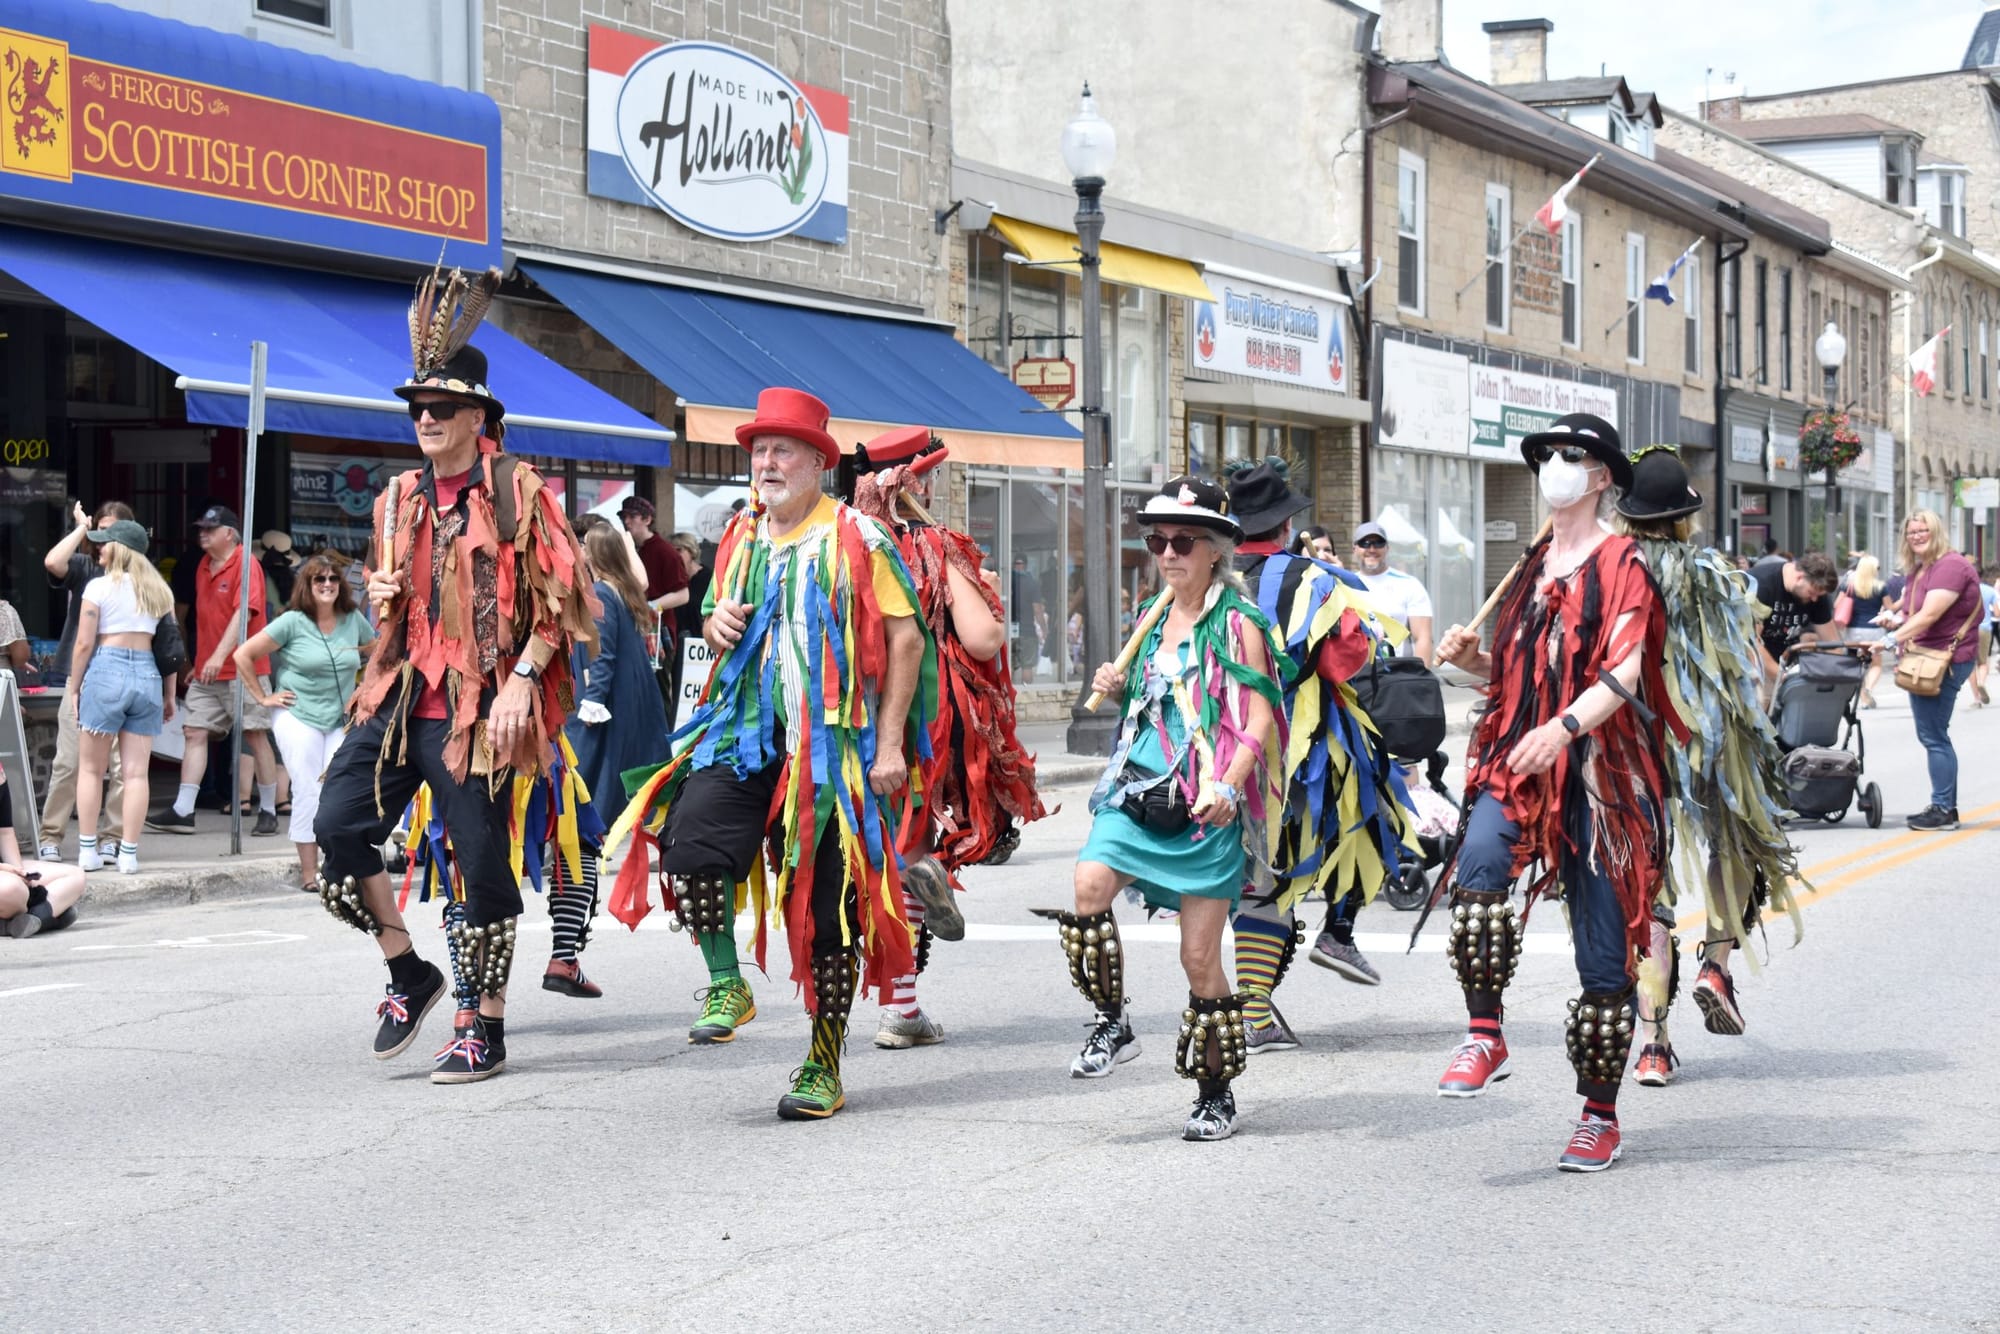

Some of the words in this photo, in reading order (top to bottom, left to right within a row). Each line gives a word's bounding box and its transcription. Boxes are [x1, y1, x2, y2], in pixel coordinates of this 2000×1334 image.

[109, 72, 203, 116] FERGUS
[699, 74, 746, 99] MADE
[757, 89, 773, 105] IN
[639, 69, 794, 189] Holland
[83, 101, 257, 191] SCOTTISH
[262, 151, 393, 215] CORNER
[399, 177, 475, 230] SHOP
[1225, 287, 1250, 327] Pure
[1250, 293, 1281, 335] Water
[1282, 300, 1318, 342] Canada
[1475, 372, 1498, 400] John
[1502, 376, 1542, 407] Thomson
[1544, 383, 1551, 407] &
[1554, 385, 1570, 411] Son
[1572, 389, 1612, 417] Furniture
[4, 439, 49, 467] open
